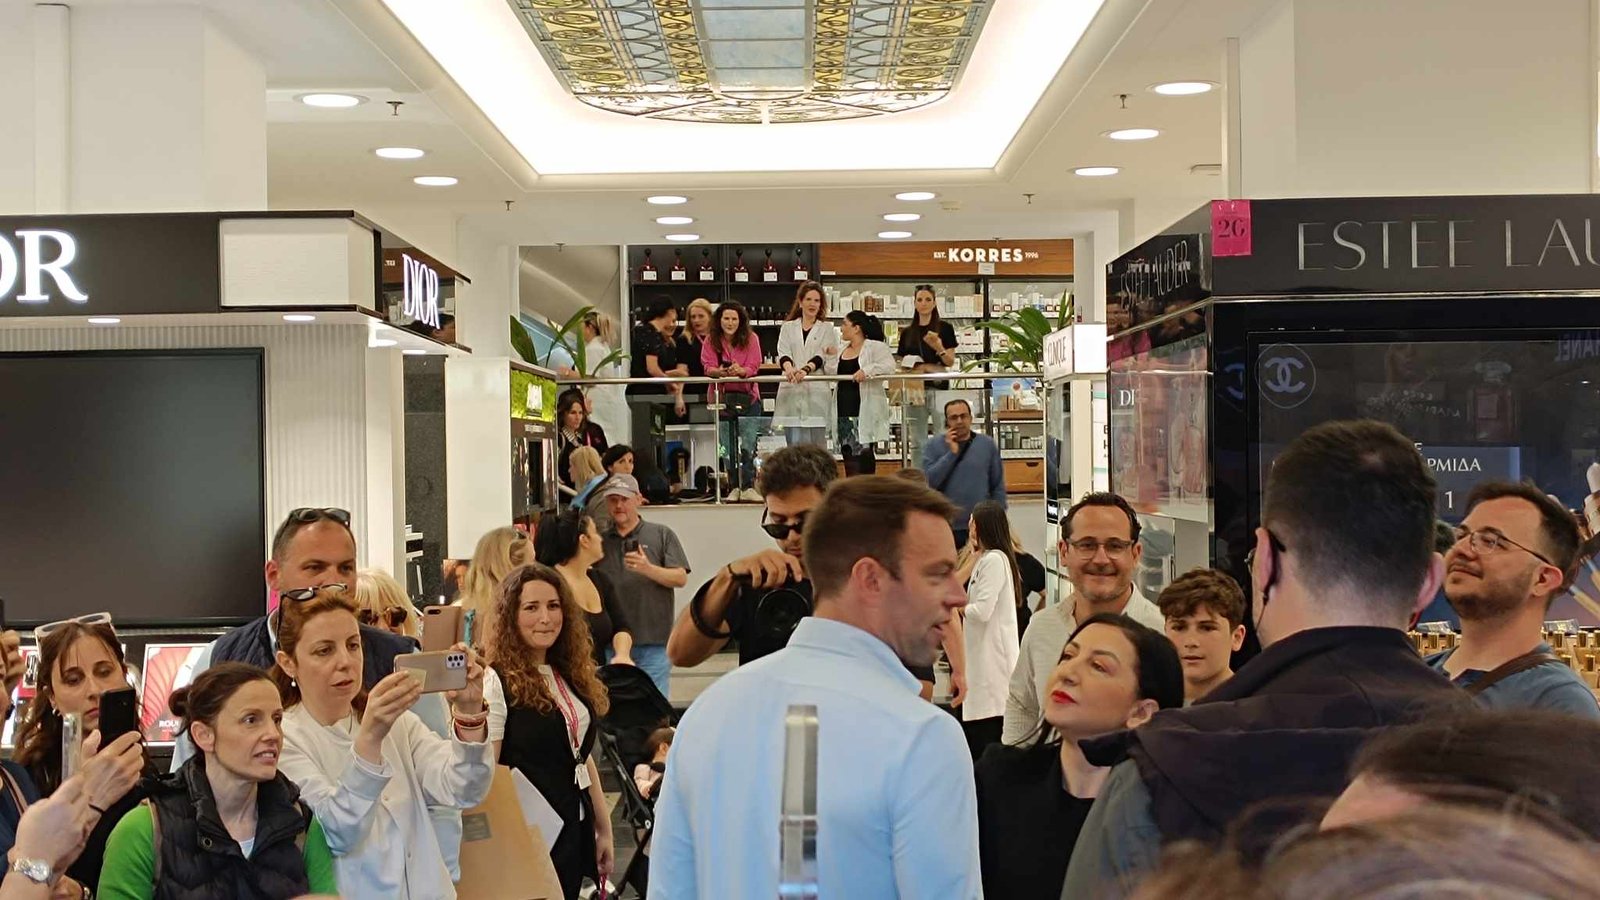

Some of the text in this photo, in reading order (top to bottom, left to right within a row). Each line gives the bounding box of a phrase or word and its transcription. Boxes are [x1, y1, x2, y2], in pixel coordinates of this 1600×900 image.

[948, 247, 1024, 263] KORRES
[1025, 251, 1040, 259] 1996
[402, 253, 441, 330] DIOR
[1427, 457, 1482, 472] ΡΜΙΔΑ
[159, 719, 180, 729] ROU
